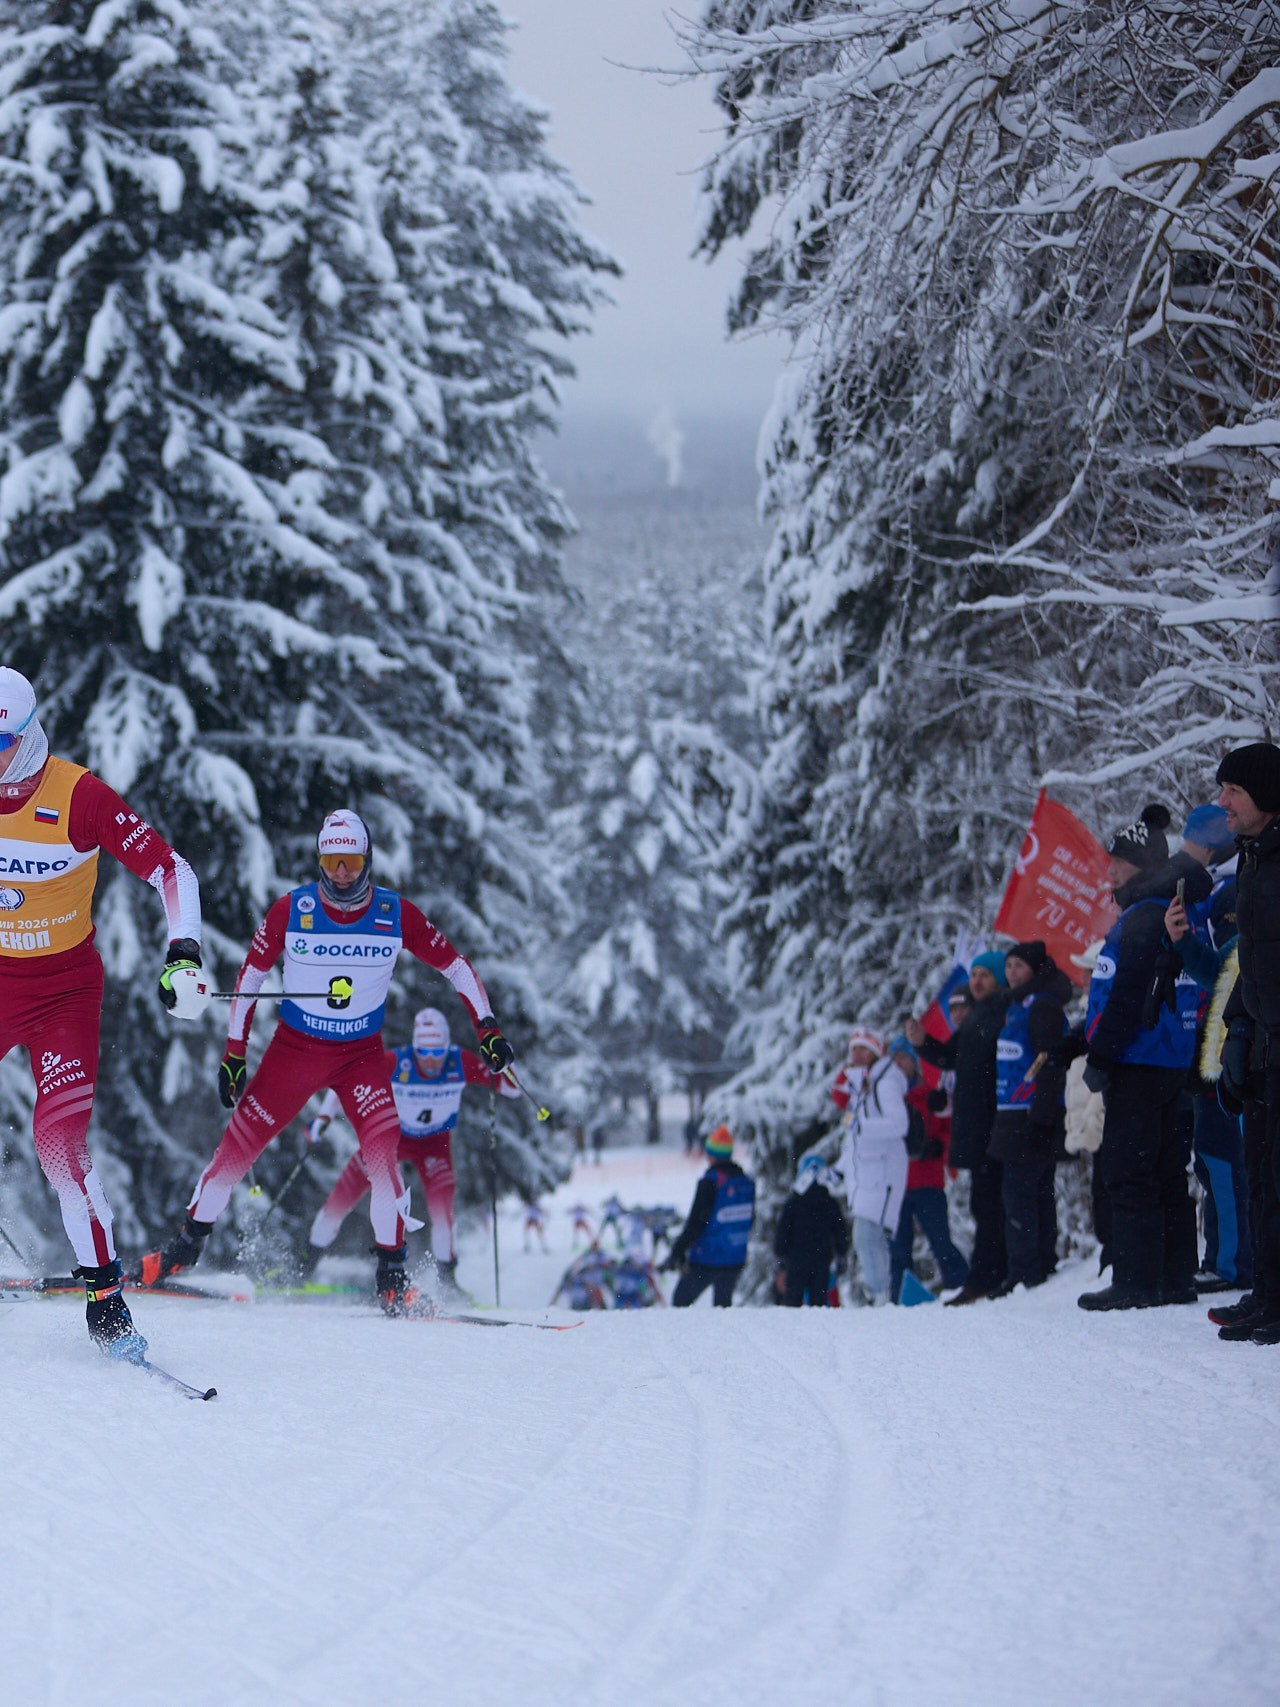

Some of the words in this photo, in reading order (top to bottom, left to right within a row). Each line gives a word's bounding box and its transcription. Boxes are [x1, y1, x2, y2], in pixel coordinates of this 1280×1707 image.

[122, 821, 151, 851] ЛУКОЙ
[17, 918, 49, 930] 2026
[51, 909, 77, 926] года
[313, 944, 393, 958] ФОСАГРО
[303, 1014, 369, 1036] ЧЕПЕЦКОЕ
[39, 1058, 82, 1087] ФОСАГРО
[42, 1070, 86, 1095] BIVIUM
[416, 1108, 432, 1124] 4
